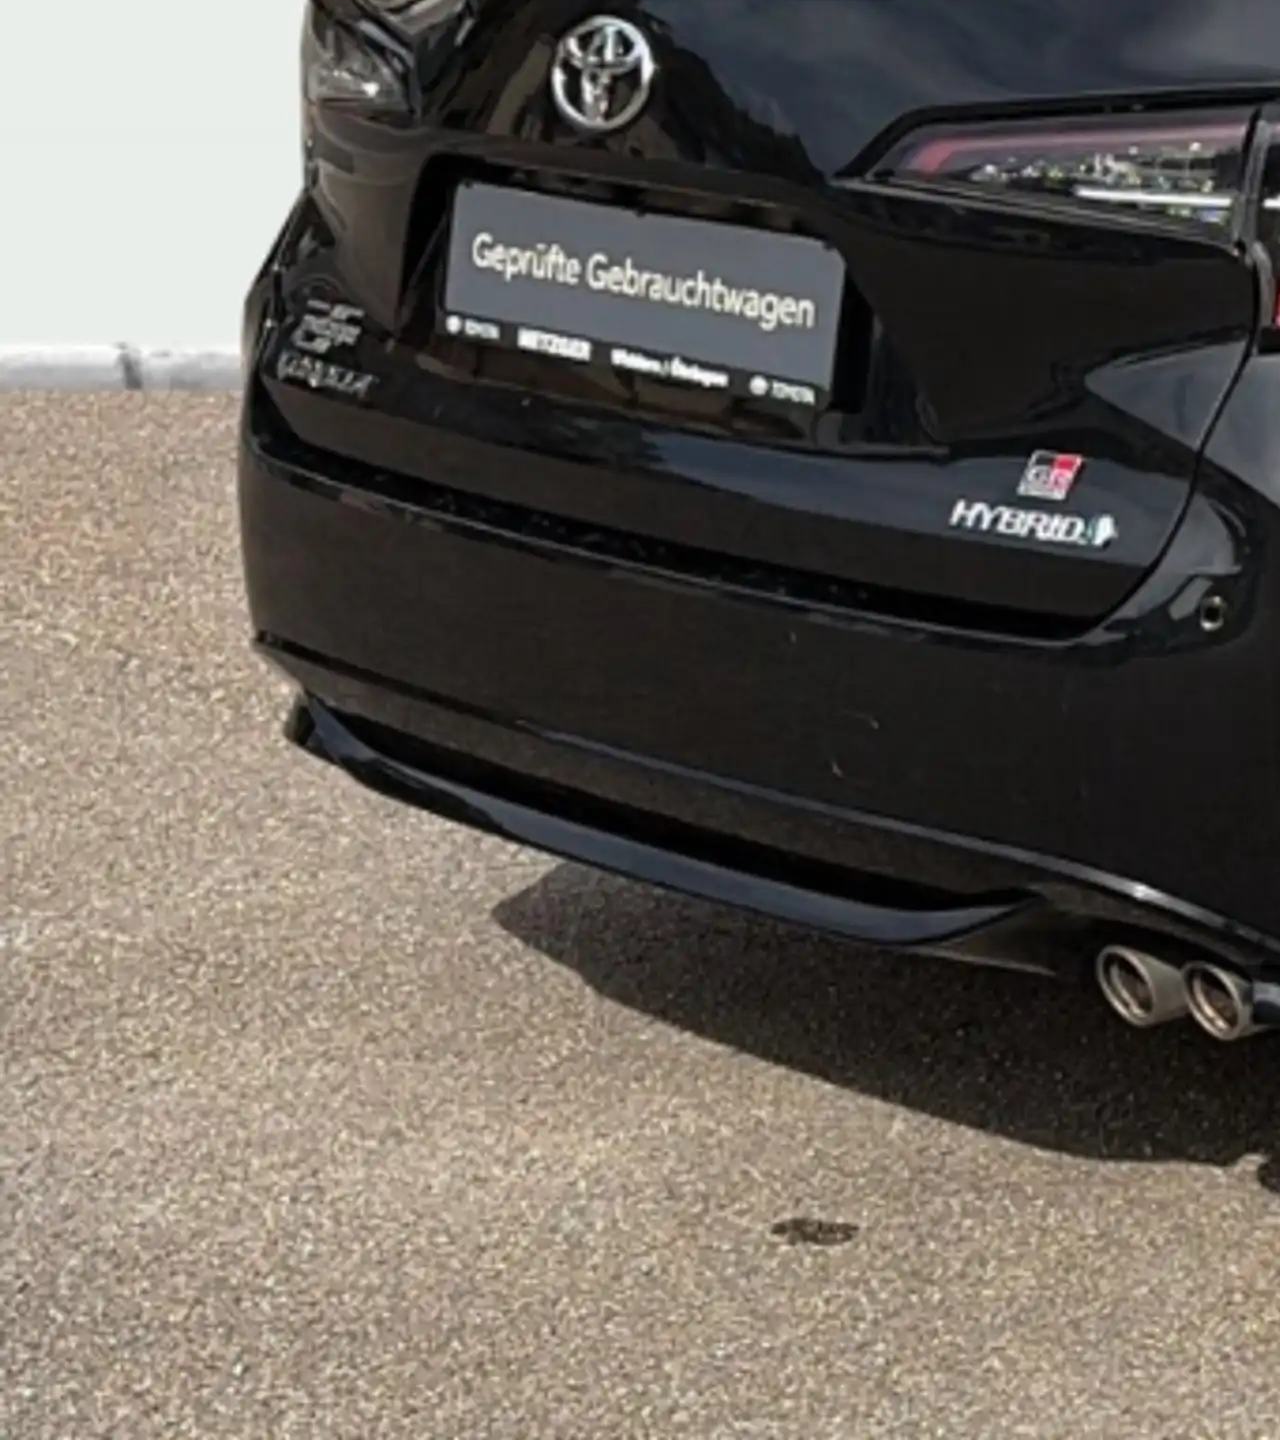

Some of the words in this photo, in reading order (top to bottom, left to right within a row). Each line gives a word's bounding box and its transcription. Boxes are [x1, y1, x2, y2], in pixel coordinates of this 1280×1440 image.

[472, 232, 581, 286] Geprüfte
[585, 253, 815, 331] Gebrauchtwagen
[949, 498, 1083, 544] HYBRID
